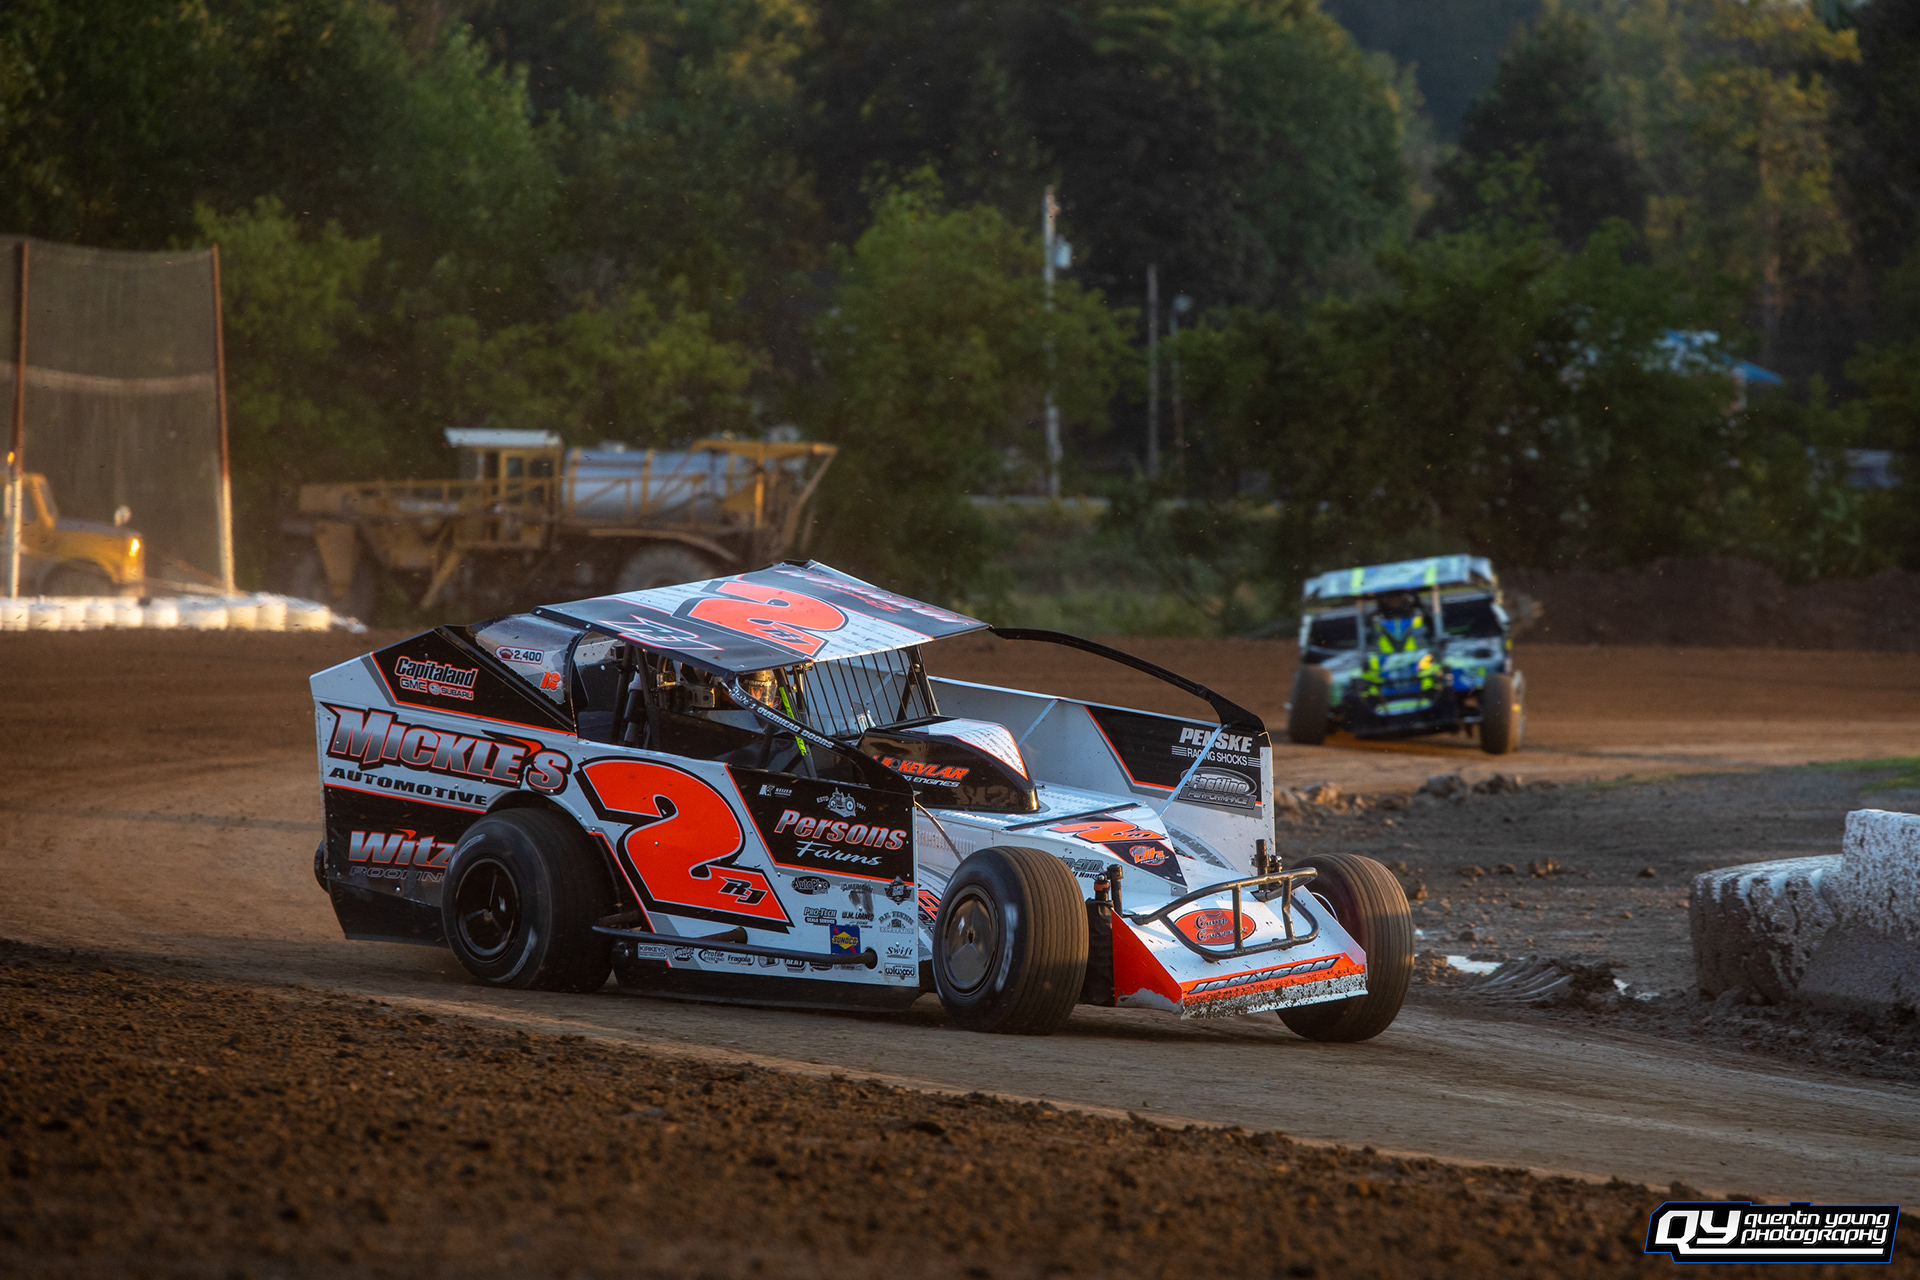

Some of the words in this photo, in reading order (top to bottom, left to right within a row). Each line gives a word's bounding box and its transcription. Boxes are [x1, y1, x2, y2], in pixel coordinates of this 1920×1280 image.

[680, 581, 847, 657] 2
[513, 651, 541, 662] 2,400
[395, 656, 478, 688] Capitaland
[401, 679, 427, 691] GMC
[441, 687, 473, 699] SUBARU
[757, 706, 801, 733] OVERHEAD
[800, 729, 834, 749] DOORS
[1179, 727, 1252, 753] PENSKE
[898, 760, 969, 779] KEVLAR
[1216, 754, 1248, 766] SHOCKS
[329, 767, 487, 806] AUTOMOTIVE
[913, 777, 960, 788] ENGINES
[1190, 774, 1247, 793] Fastline
[1188, 791, 1248, 804] PERFORMANCE
[774, 809, 907, 850] Persons
[1048, 821, 1166, 843] 2
[348, 829, 457, 869] Witz
[577, 757, 793, 928] 2
[796, 840, 883, 866] Farms
[349, 866, 444, 882] ROOFIN
[804, 907, 837, 917] PRO-TECH
[639, 945, 662, 953] KIRKEY
[833, 936, 858, 945] SUNOCO
[727, 955, 751, 963] Fragola
[885, 946, 913, 955] Swift
[1187, 957, 1340, 995] JOHNSON
